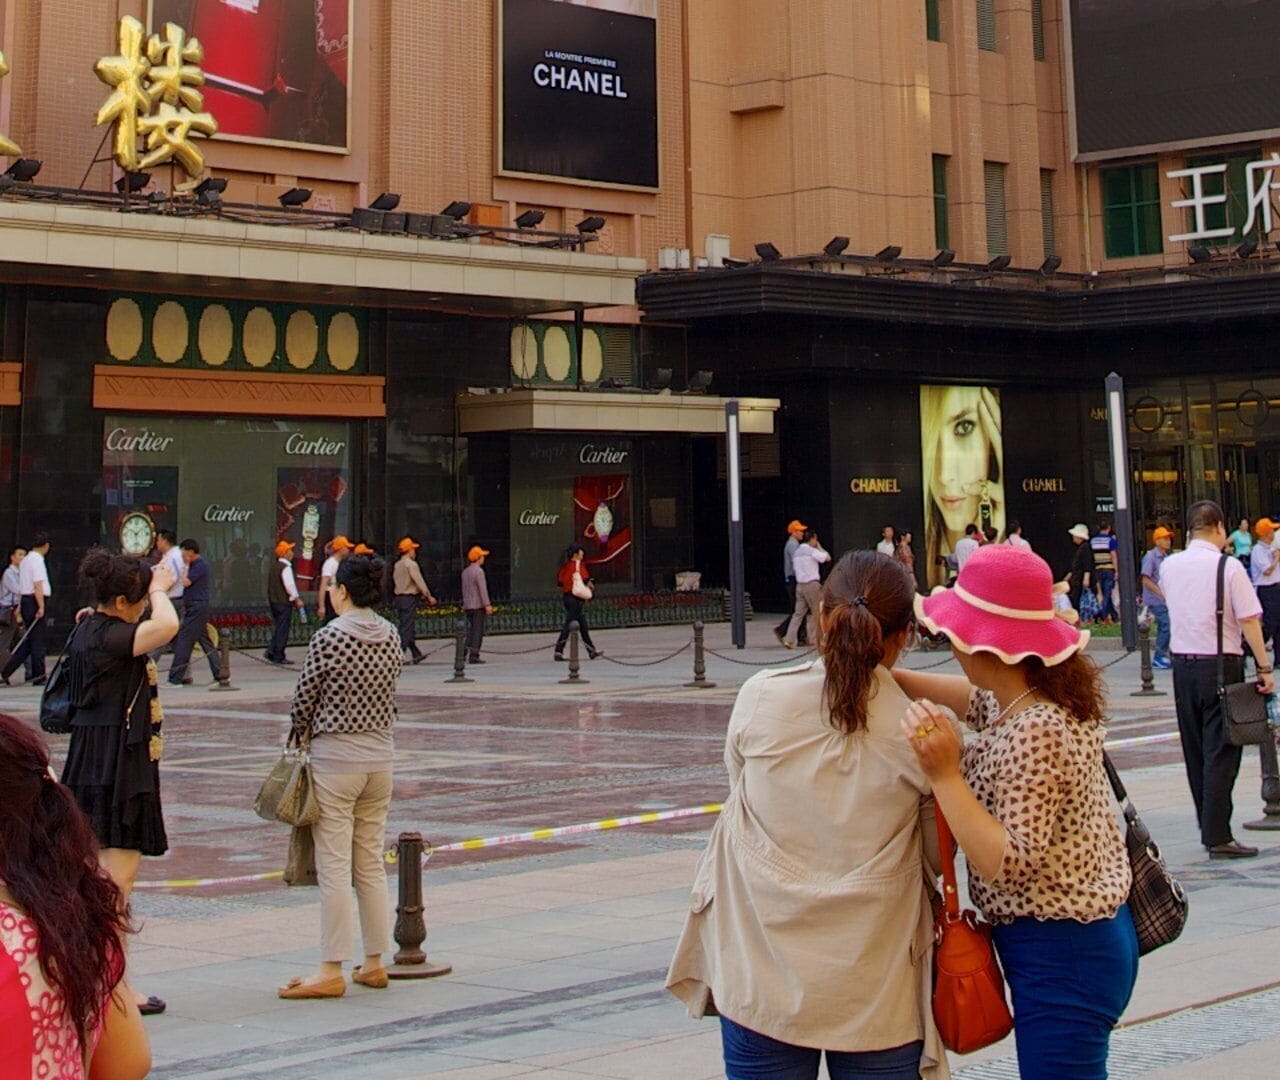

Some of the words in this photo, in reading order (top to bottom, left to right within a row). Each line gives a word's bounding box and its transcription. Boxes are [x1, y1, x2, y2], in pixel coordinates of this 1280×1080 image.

[533, 63, 628, 99] CHANEL
[106, 427, 173, 452] Cartier
[285, 433, 346, 455] Cartier
[579, 443, 628, 464] Cartier
[850, 477, 902, 493] CHANEL
[1022, 477, 1067, 492] CHANEL
[204, 503, 255, 522] Cartier
[520, 508, 560, 525] Cartier
